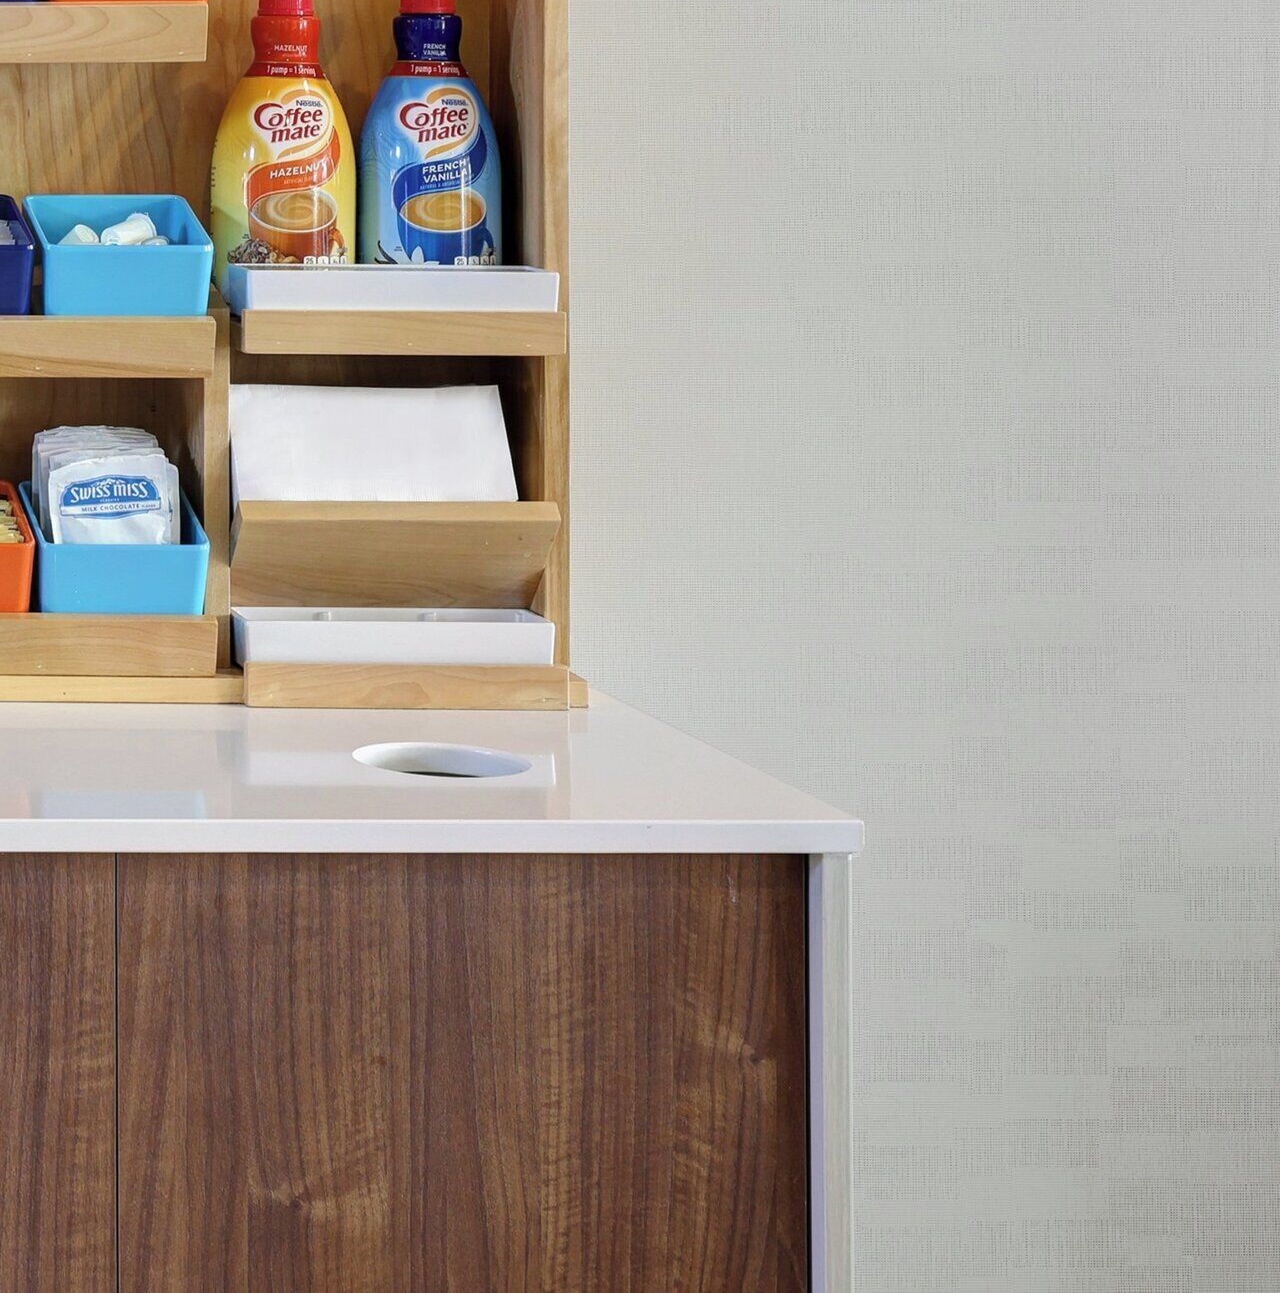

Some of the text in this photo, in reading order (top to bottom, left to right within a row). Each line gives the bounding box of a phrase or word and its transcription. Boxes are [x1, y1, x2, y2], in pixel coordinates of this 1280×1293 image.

[254, 102, 323, 130] Coffee
[400, 102, 469, 130] Coffee
[271, 124, 320, 143] mate
[418, 123, 467, 143] mate
[422, 159, 466, 175] FRENCH
